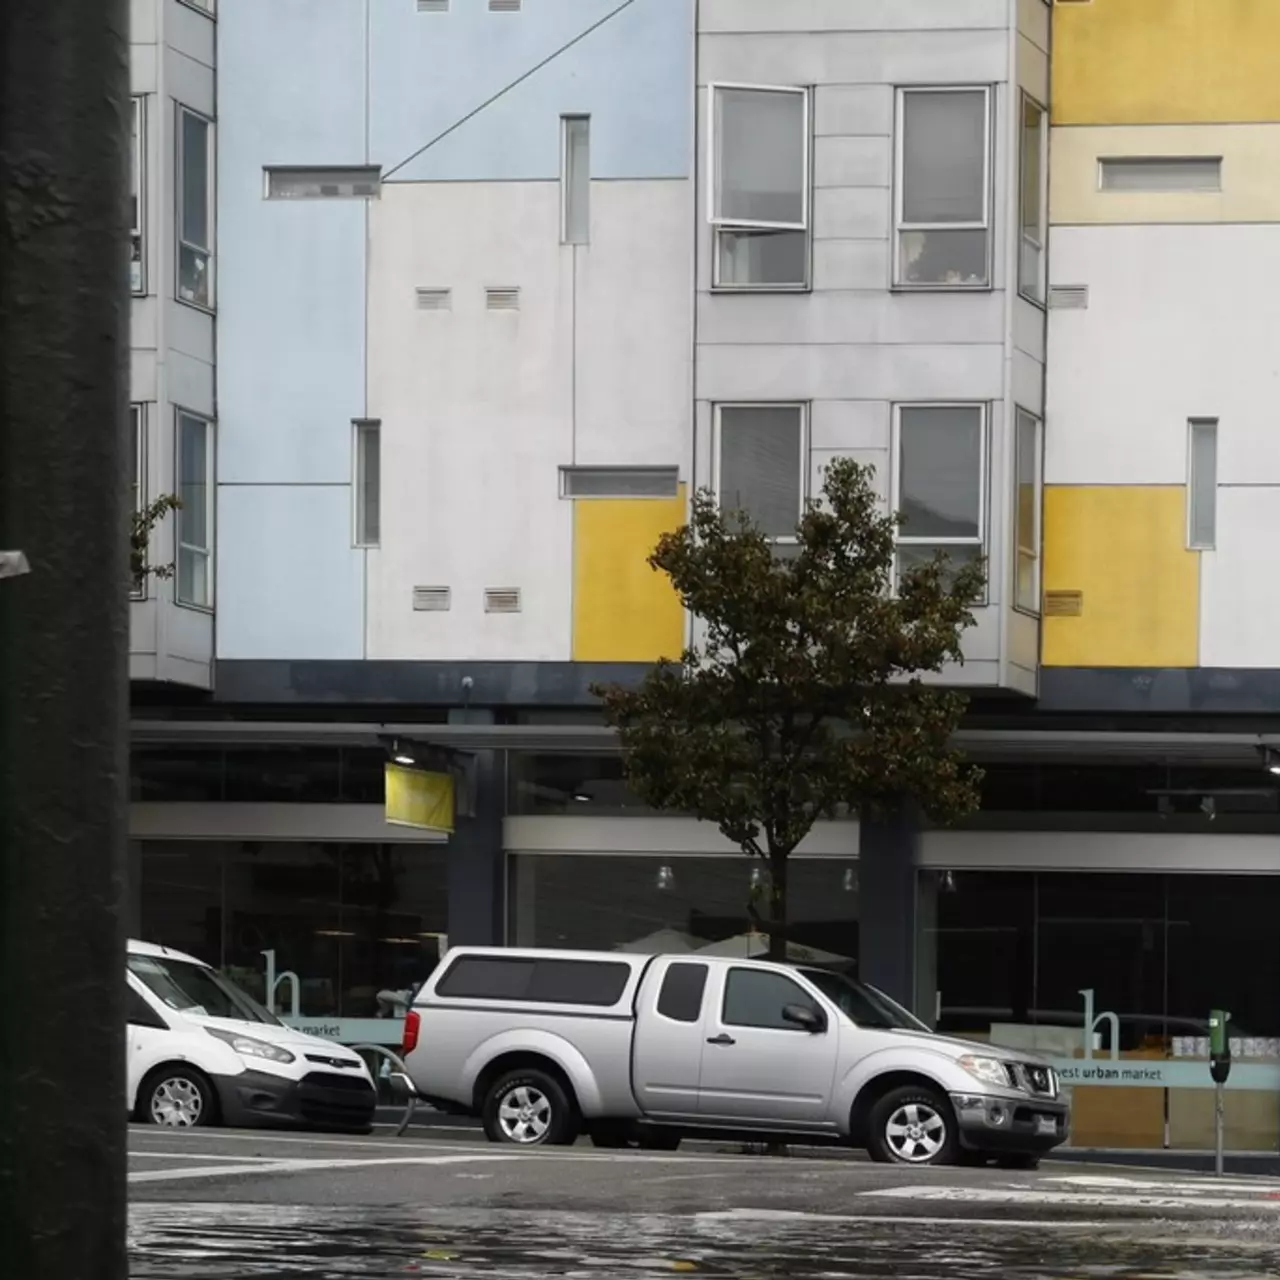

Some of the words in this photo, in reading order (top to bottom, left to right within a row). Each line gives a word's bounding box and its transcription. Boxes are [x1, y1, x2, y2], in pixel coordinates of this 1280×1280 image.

[302, 1023, 341, 1037] market
[1078, 988, 1120, 1060] h
[1057, 1067, 1080, 1078] vest
[1082, 1065, 1119, 1079] urban
[1121, 1067, 1163, 1080] market
